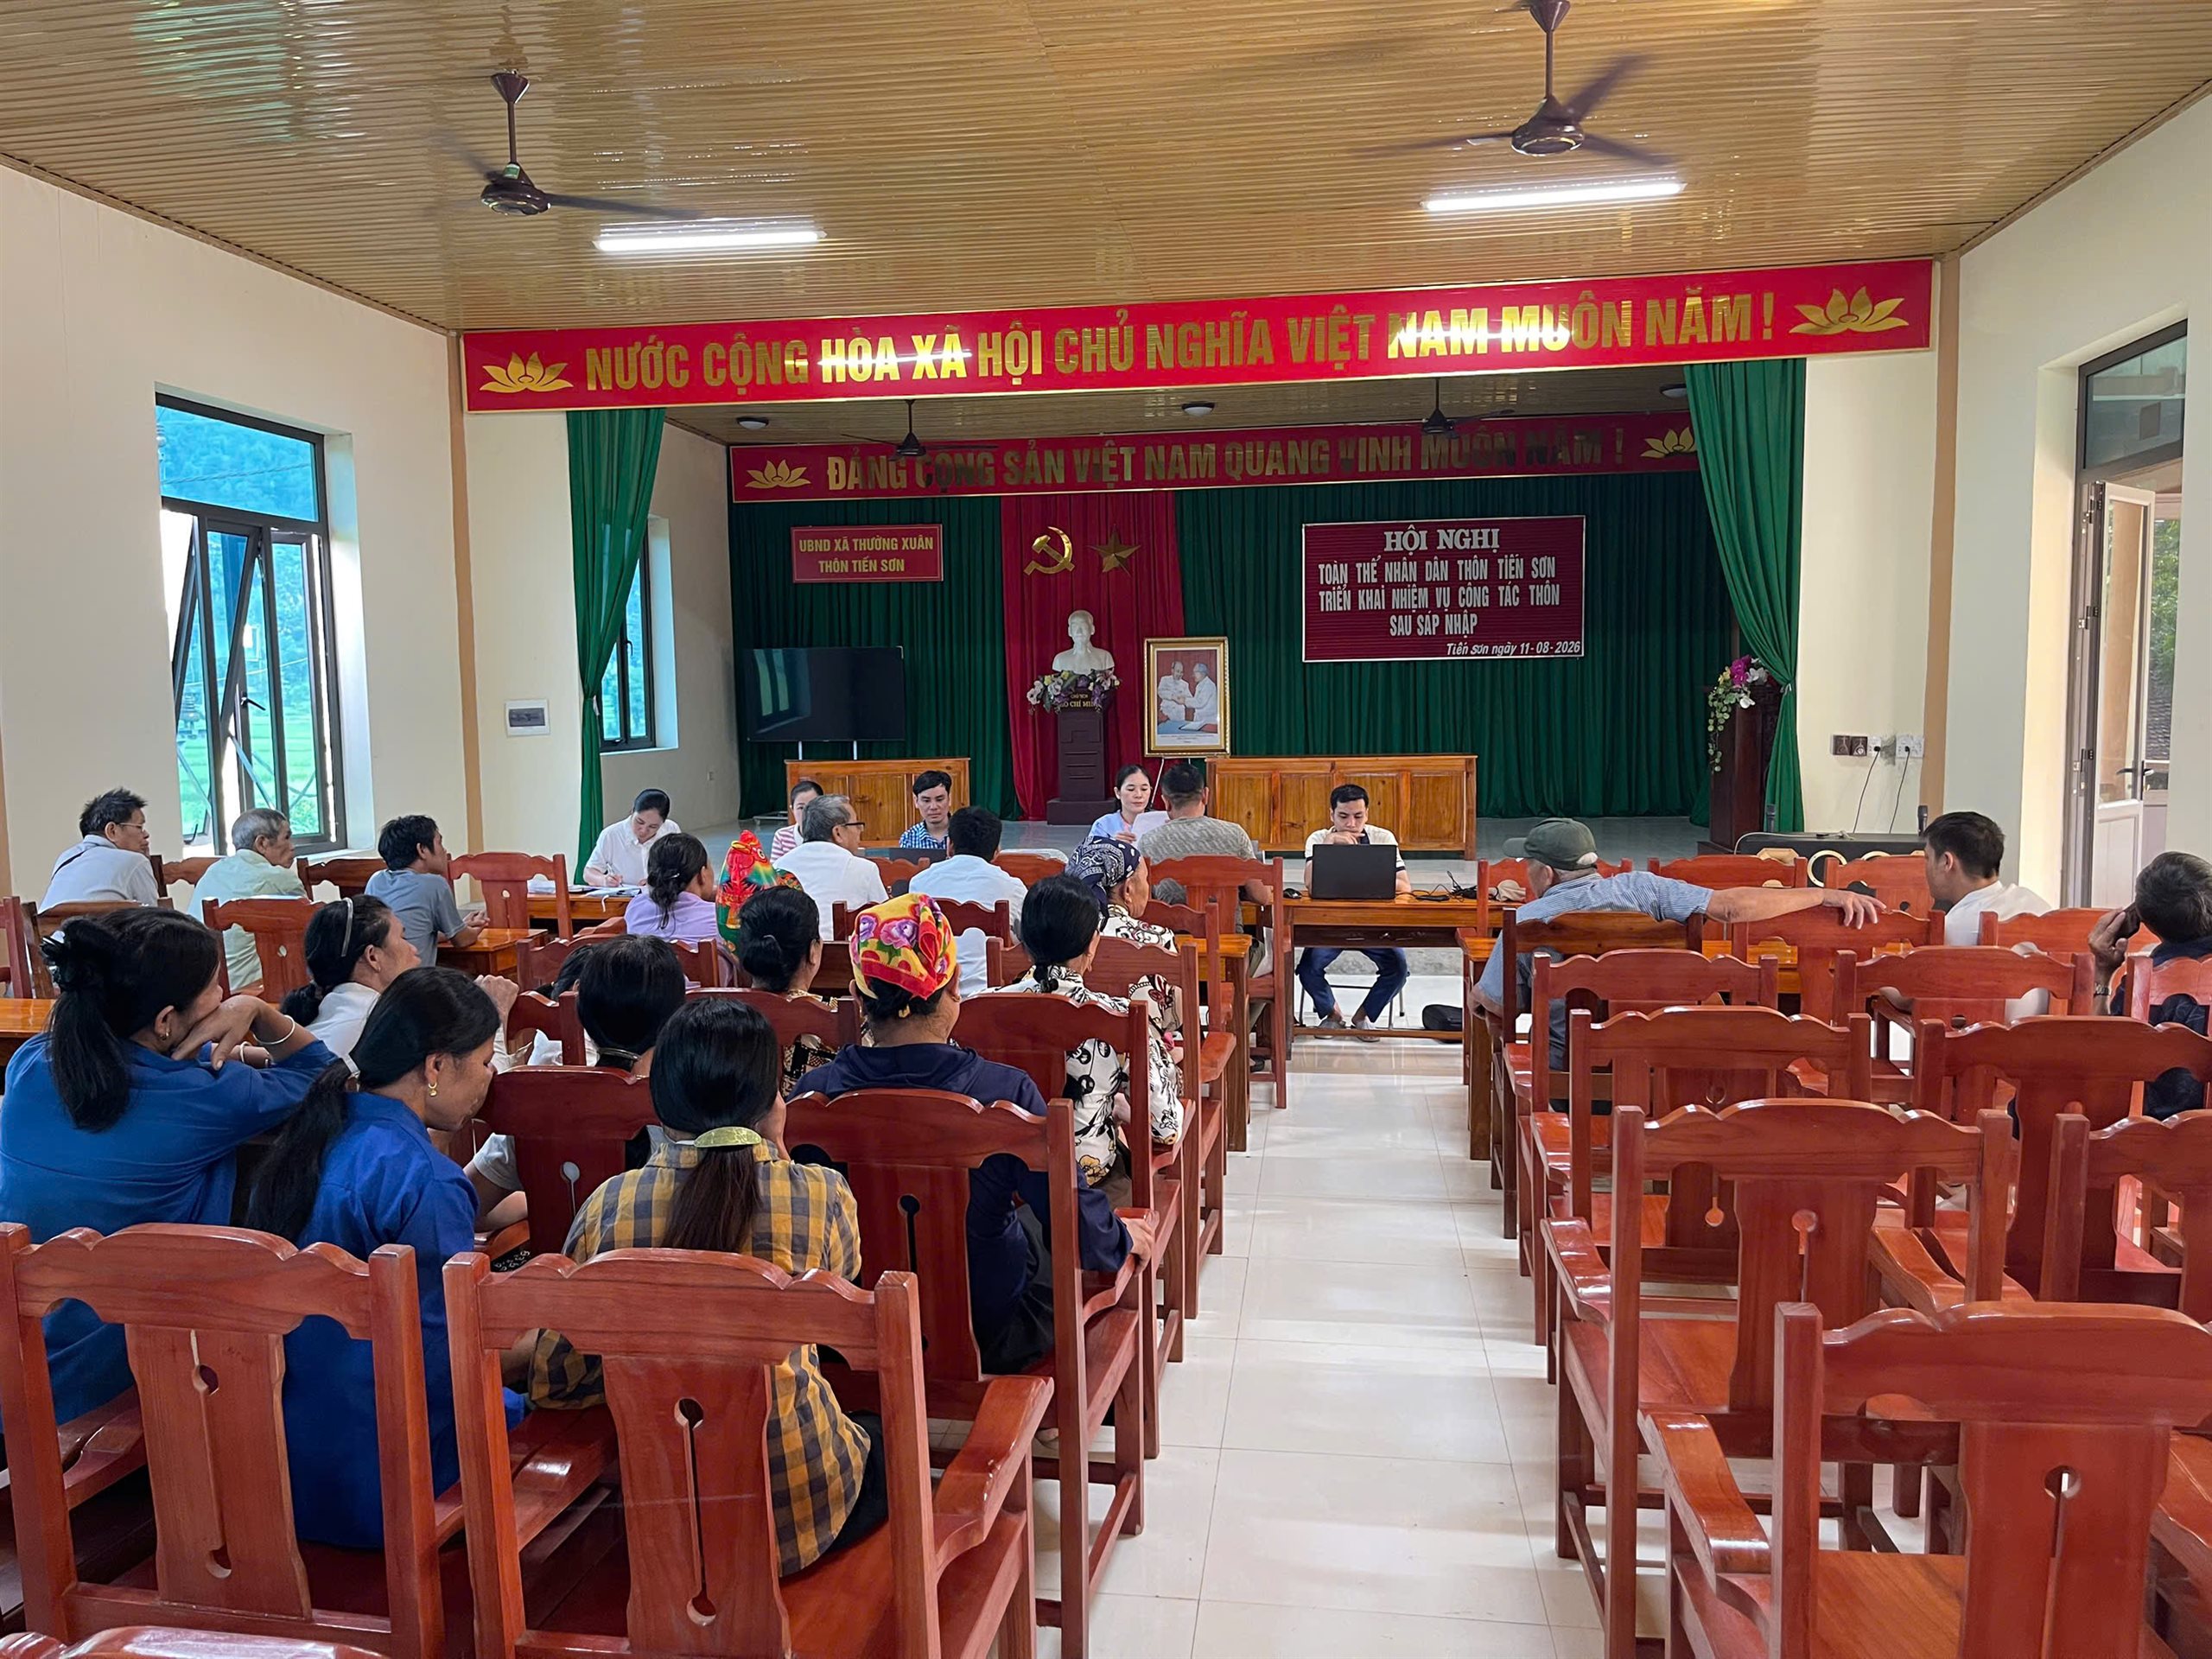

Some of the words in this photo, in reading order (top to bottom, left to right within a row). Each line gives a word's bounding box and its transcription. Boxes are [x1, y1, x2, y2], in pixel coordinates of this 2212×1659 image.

[586, 334, 690, 391] NƯỚC
[702, 332, 809, 395] CỘNG
[820, 327, 900, 383] HÒA
[912, 324, 968, 380] XÃ
[977, 320, 1042, 385] HỘI
[1054, 308, 1135, 373] CHỦ
[1146, 310, 1274, 370] NGHĨA
[1287, 304, 1376, 370] VIỆT
[1387, 308, 1488, 359] NAM
[1501, 290, 1632, 352] MUÔN
[1645, 286, 1751, 346] NĂM
[827, 447, 907, 490] ĐẢNG
[1003, 439, 1065, 485] SẢN
[1072, 440, 1135, 490] VIỆT
[1145, 443, 1217, 480] NAM
[1224, 439, 1330, 481] QUANG
[1339, 435, 1412, 472] VINH
[1421, 426, 1516, 470] MUÔN
[1525, 423, 1604, 467] NĂM
[799, 539, 830, 552] UBND
[834, 537, 849, 551] XÃ
[852, 535, 899, 550] THƯỜNG
[901, 535, 933, 550] XUÂN
[1383, 524, 1428, 556] HỘI
[1436, 528, 1500, 553] NGHỊ
[818, 557, 849, 573] THÔN
[852, 556, 878, 572] TIẾN
[880, 557, 905, 572] SƠN
[1318, 560, 1348, 585] TOÀN
[1384, 556, 1417, 582] NHÂN
[1425, 556, 1448, 582] DÂN
[1457, 555, 1488, 581] THÔN
[1531, 556, 1555, 579] SƠN
[1435, 587, 1451, 612] VỤ
[1459, 582, 1489, 607] CÔNG
[1498, 581, 1520, 607] TÁC
[1529, 580, 1560, 606] THÔN
[1389, 614, 1412, 636] SAU
[1416, 610, 1440, 636] SÁP
[1445, 609, 1478, 639] NHẬP
[1446, 642, 1468, 655] Tiến
[1491, 642, 1517, 657] ngày
